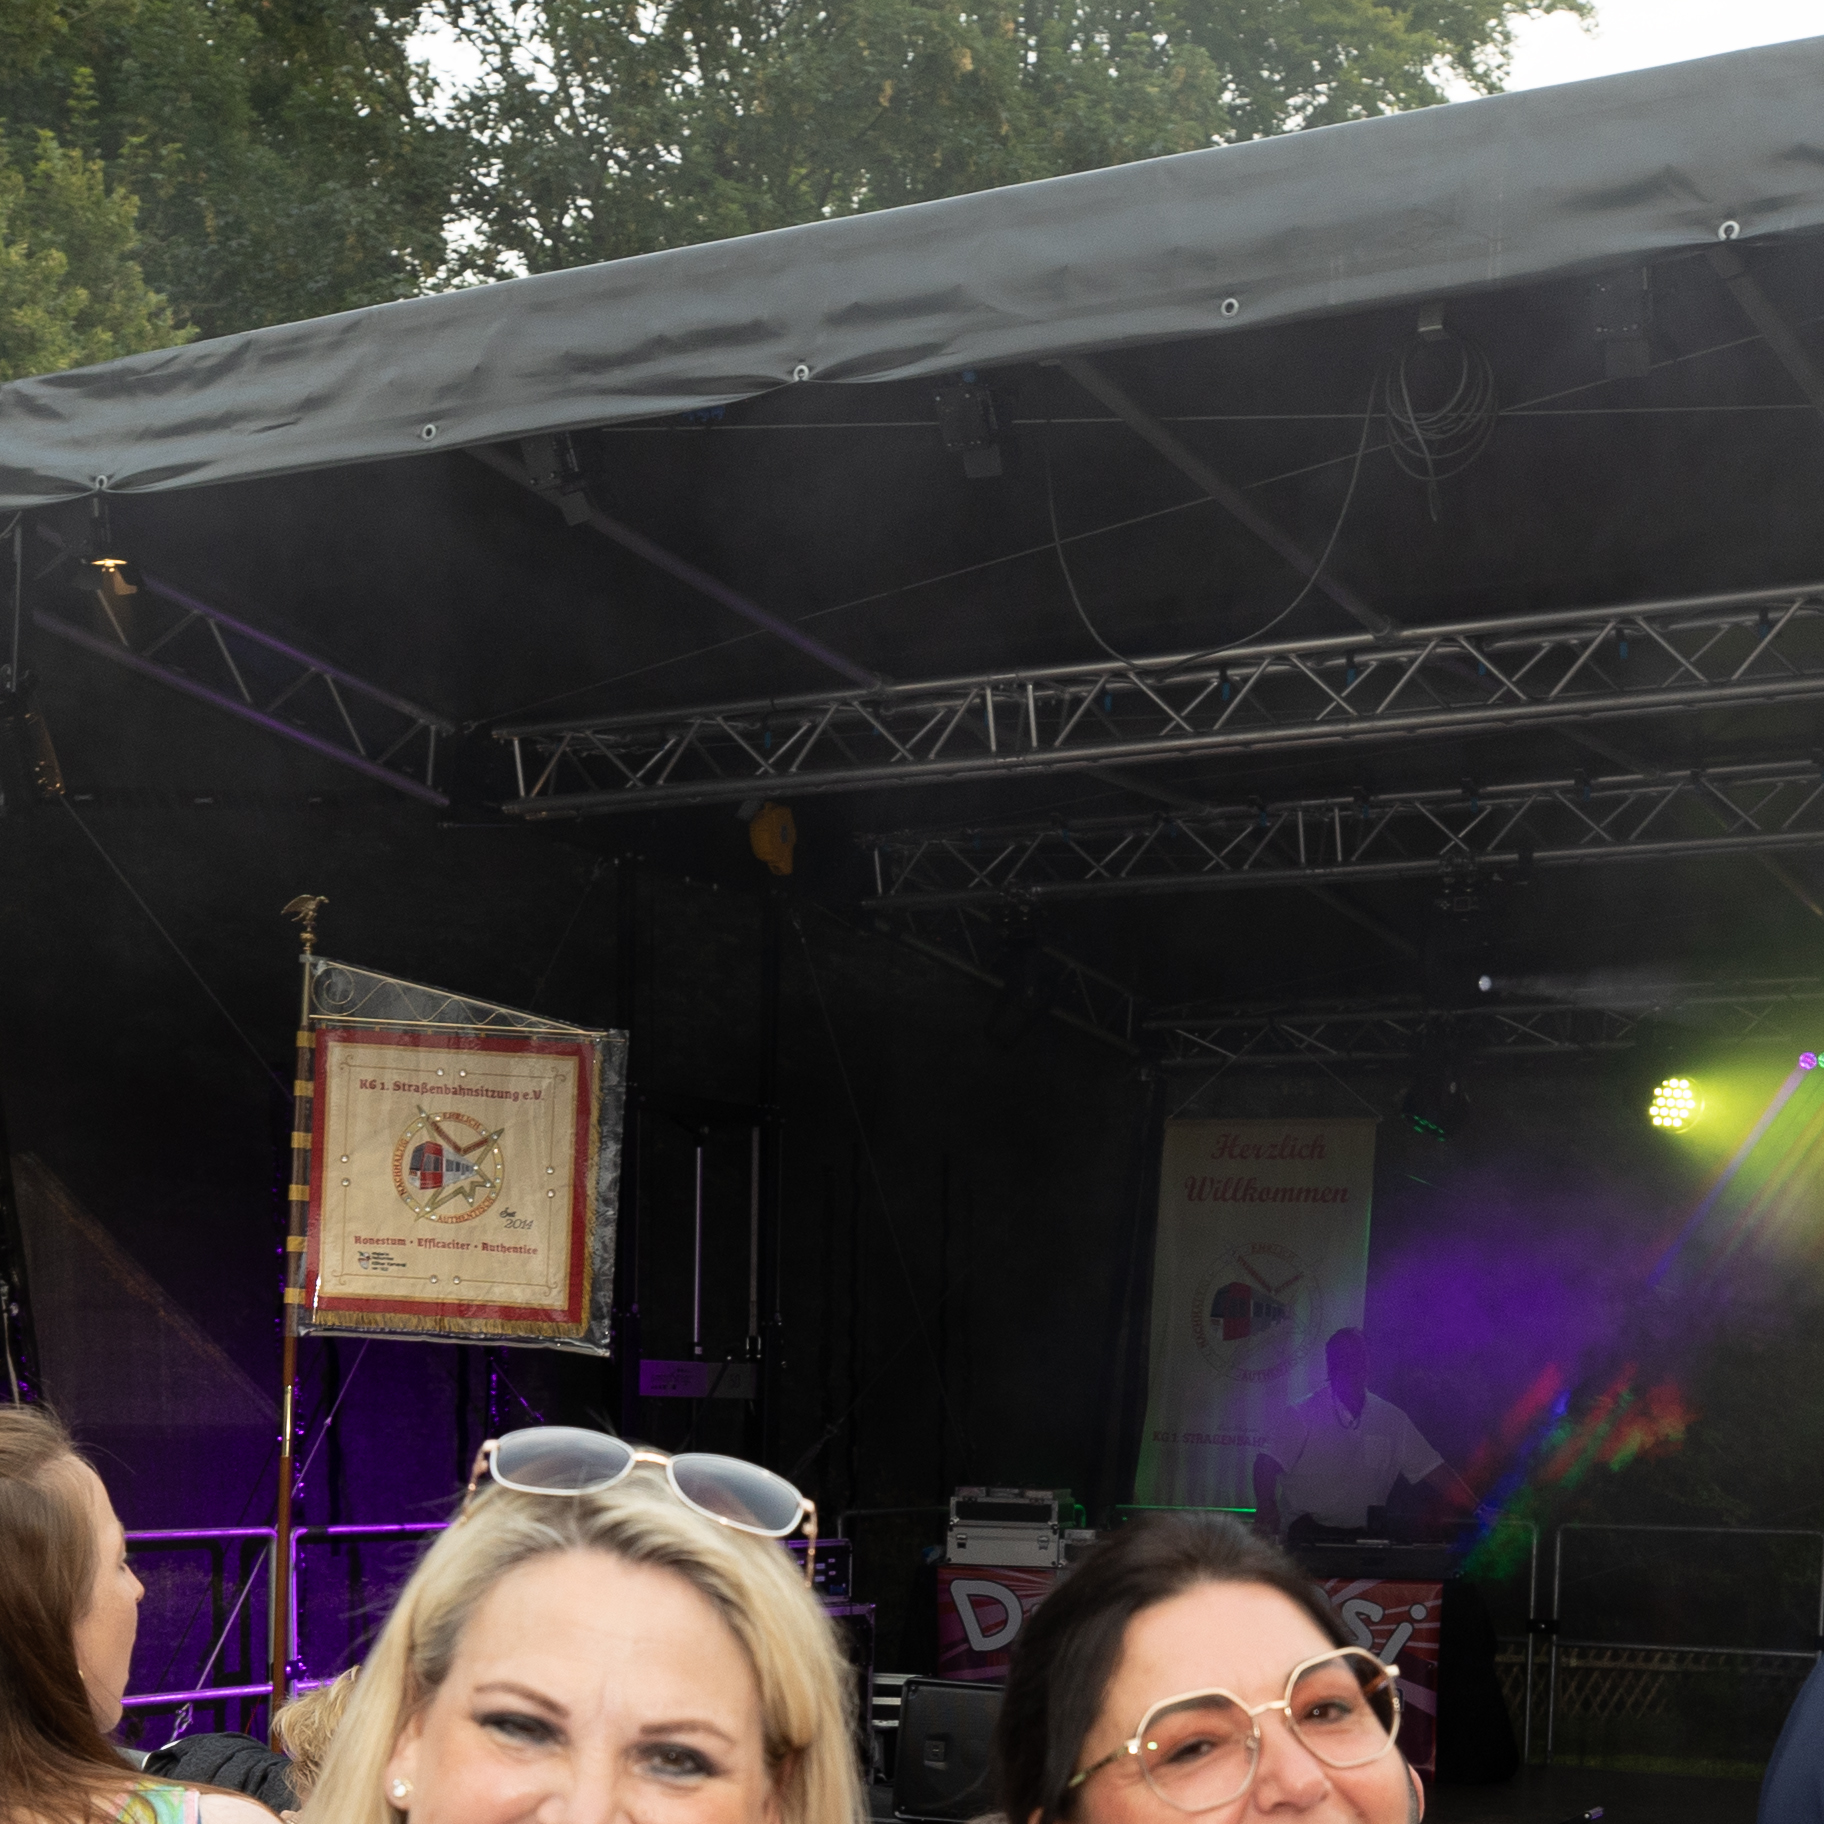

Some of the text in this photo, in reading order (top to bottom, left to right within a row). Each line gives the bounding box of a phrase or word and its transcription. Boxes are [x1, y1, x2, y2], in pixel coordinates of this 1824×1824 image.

[392, 1080, 520, 1102] Straßenbahnsitzung
[1210, 1132, 1326, 1160] Herzlich
[1183, 1176, 1349, 1203] Willkommen
[504, 1218, 534, 1230] 2014
